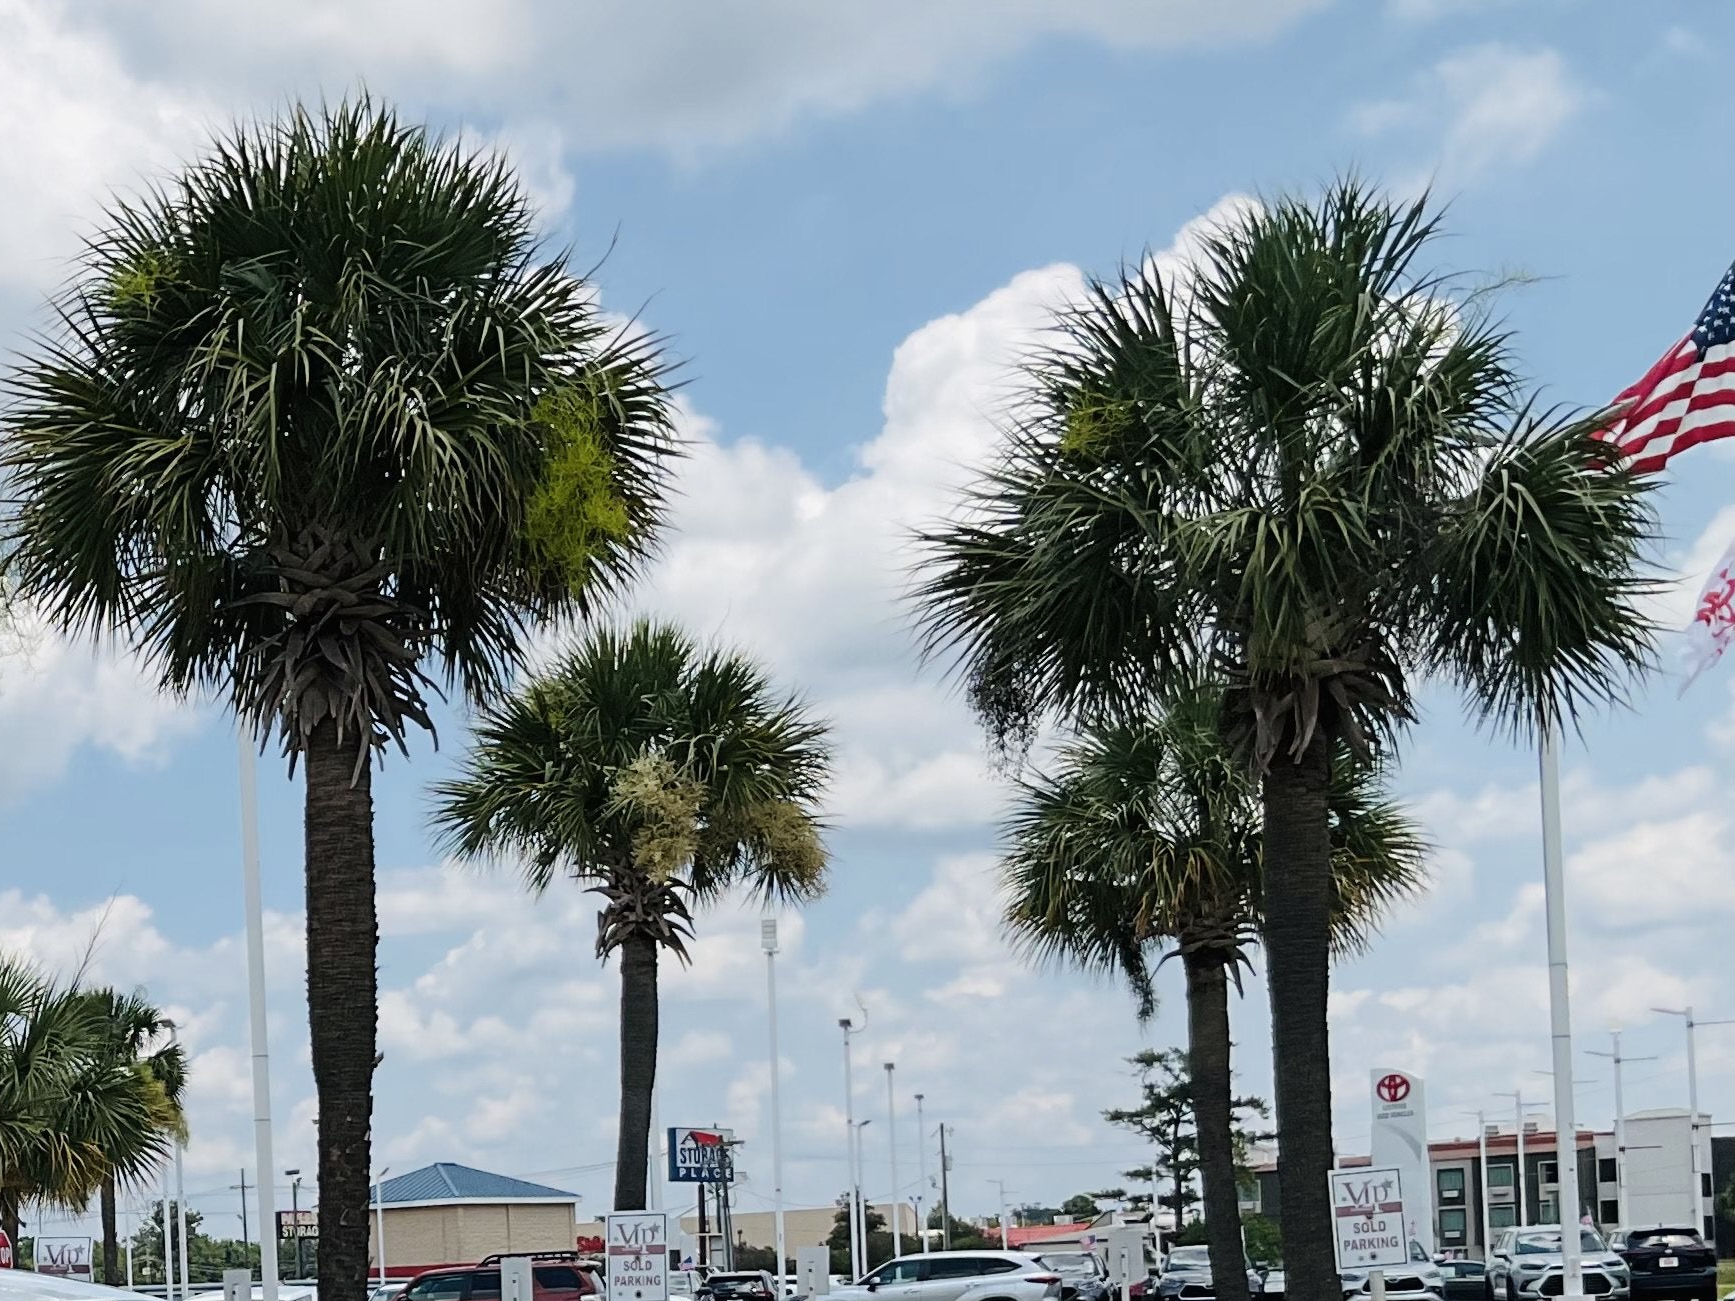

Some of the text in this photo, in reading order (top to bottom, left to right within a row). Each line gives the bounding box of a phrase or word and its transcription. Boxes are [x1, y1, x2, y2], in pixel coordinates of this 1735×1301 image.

[679, 1167, 731, 1179] PLACE
[1353, 1221, 1386, 1234] SOLD
[1343, 1236, 1399, 1252] PARKING
[623, 1260, 653, 1272] SOLD
[614, 1275, 661, 1287] PARKING
